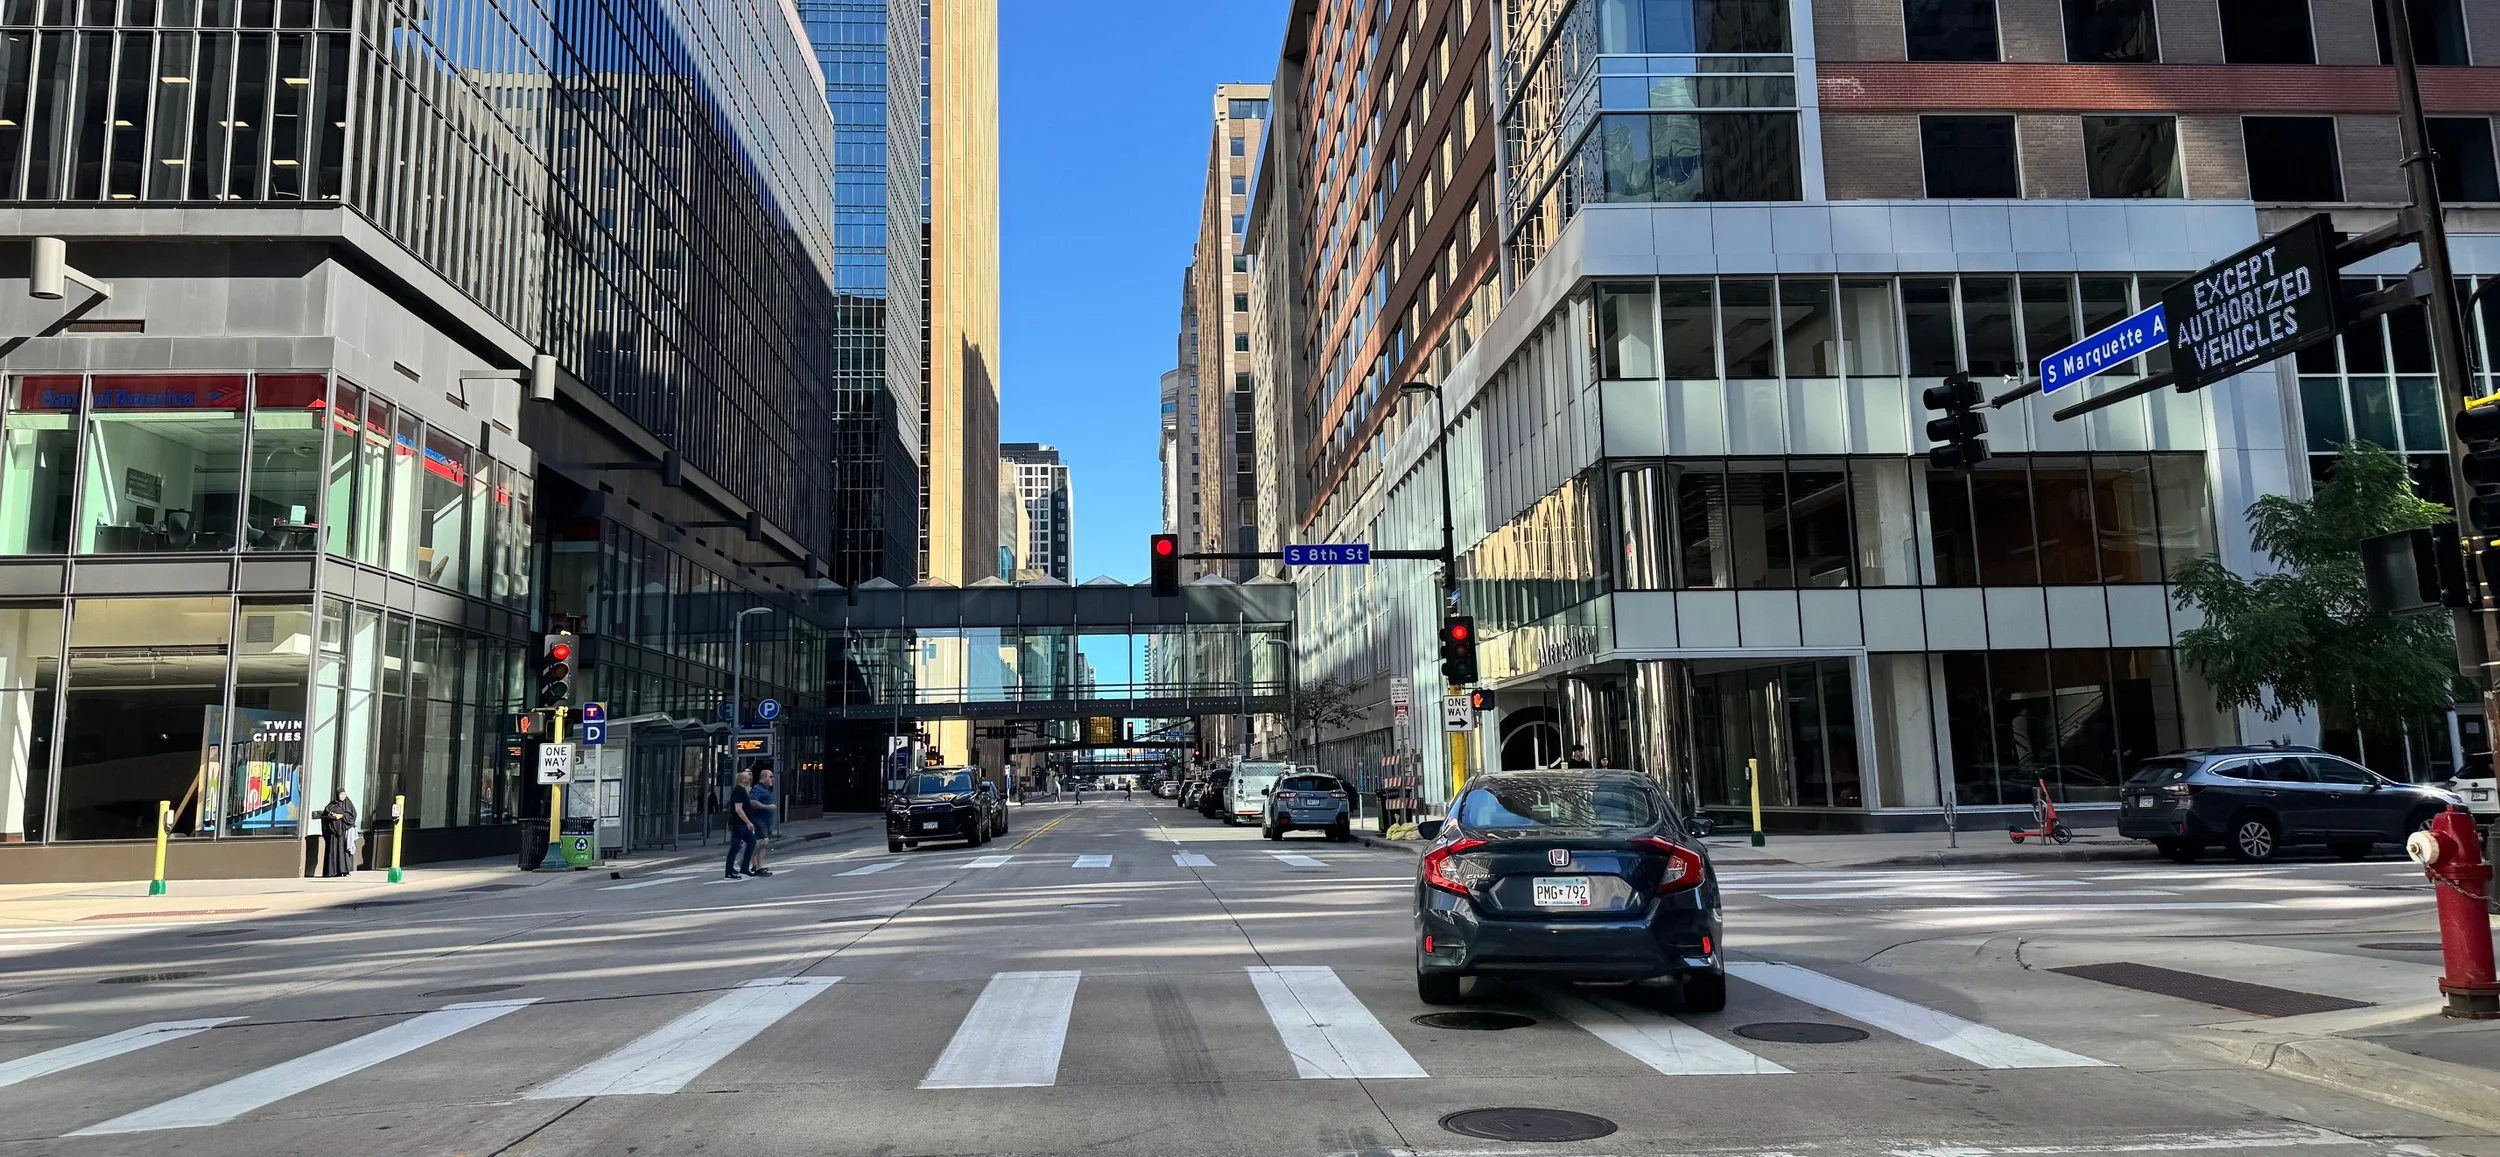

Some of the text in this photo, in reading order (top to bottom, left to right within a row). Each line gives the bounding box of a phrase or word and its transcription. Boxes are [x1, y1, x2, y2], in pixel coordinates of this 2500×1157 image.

[2193, 246, 2276, 310] EXCEPT
[2178, 266, 2312, 349] AUTHORIZED
[2194, 306, 2298, 370] VEHICLES
[2048, 364, 2057, 383] S
[2063, 328, 2143, 377] Marquette
[41, 389, 79, 407] Ban
[114, 388, 195, 407] America
[1290, 548, 1363, 561] S 8th St
[764, 702, 775, 716] P
[1448, 698, 1467, 707] ONE
[586, 707, 598, 717] T
[1447, 708, 1468, 716] WAY
[264, 720, 303, 730] TWIN
[253, 732, 302, 742] CITIES
[587, 726, 601, 741] D
[545, 746, 567, 756] ONE
[544, 757, 568, 767] WAY
[1537, 885, 1586, 900] PMG 792
